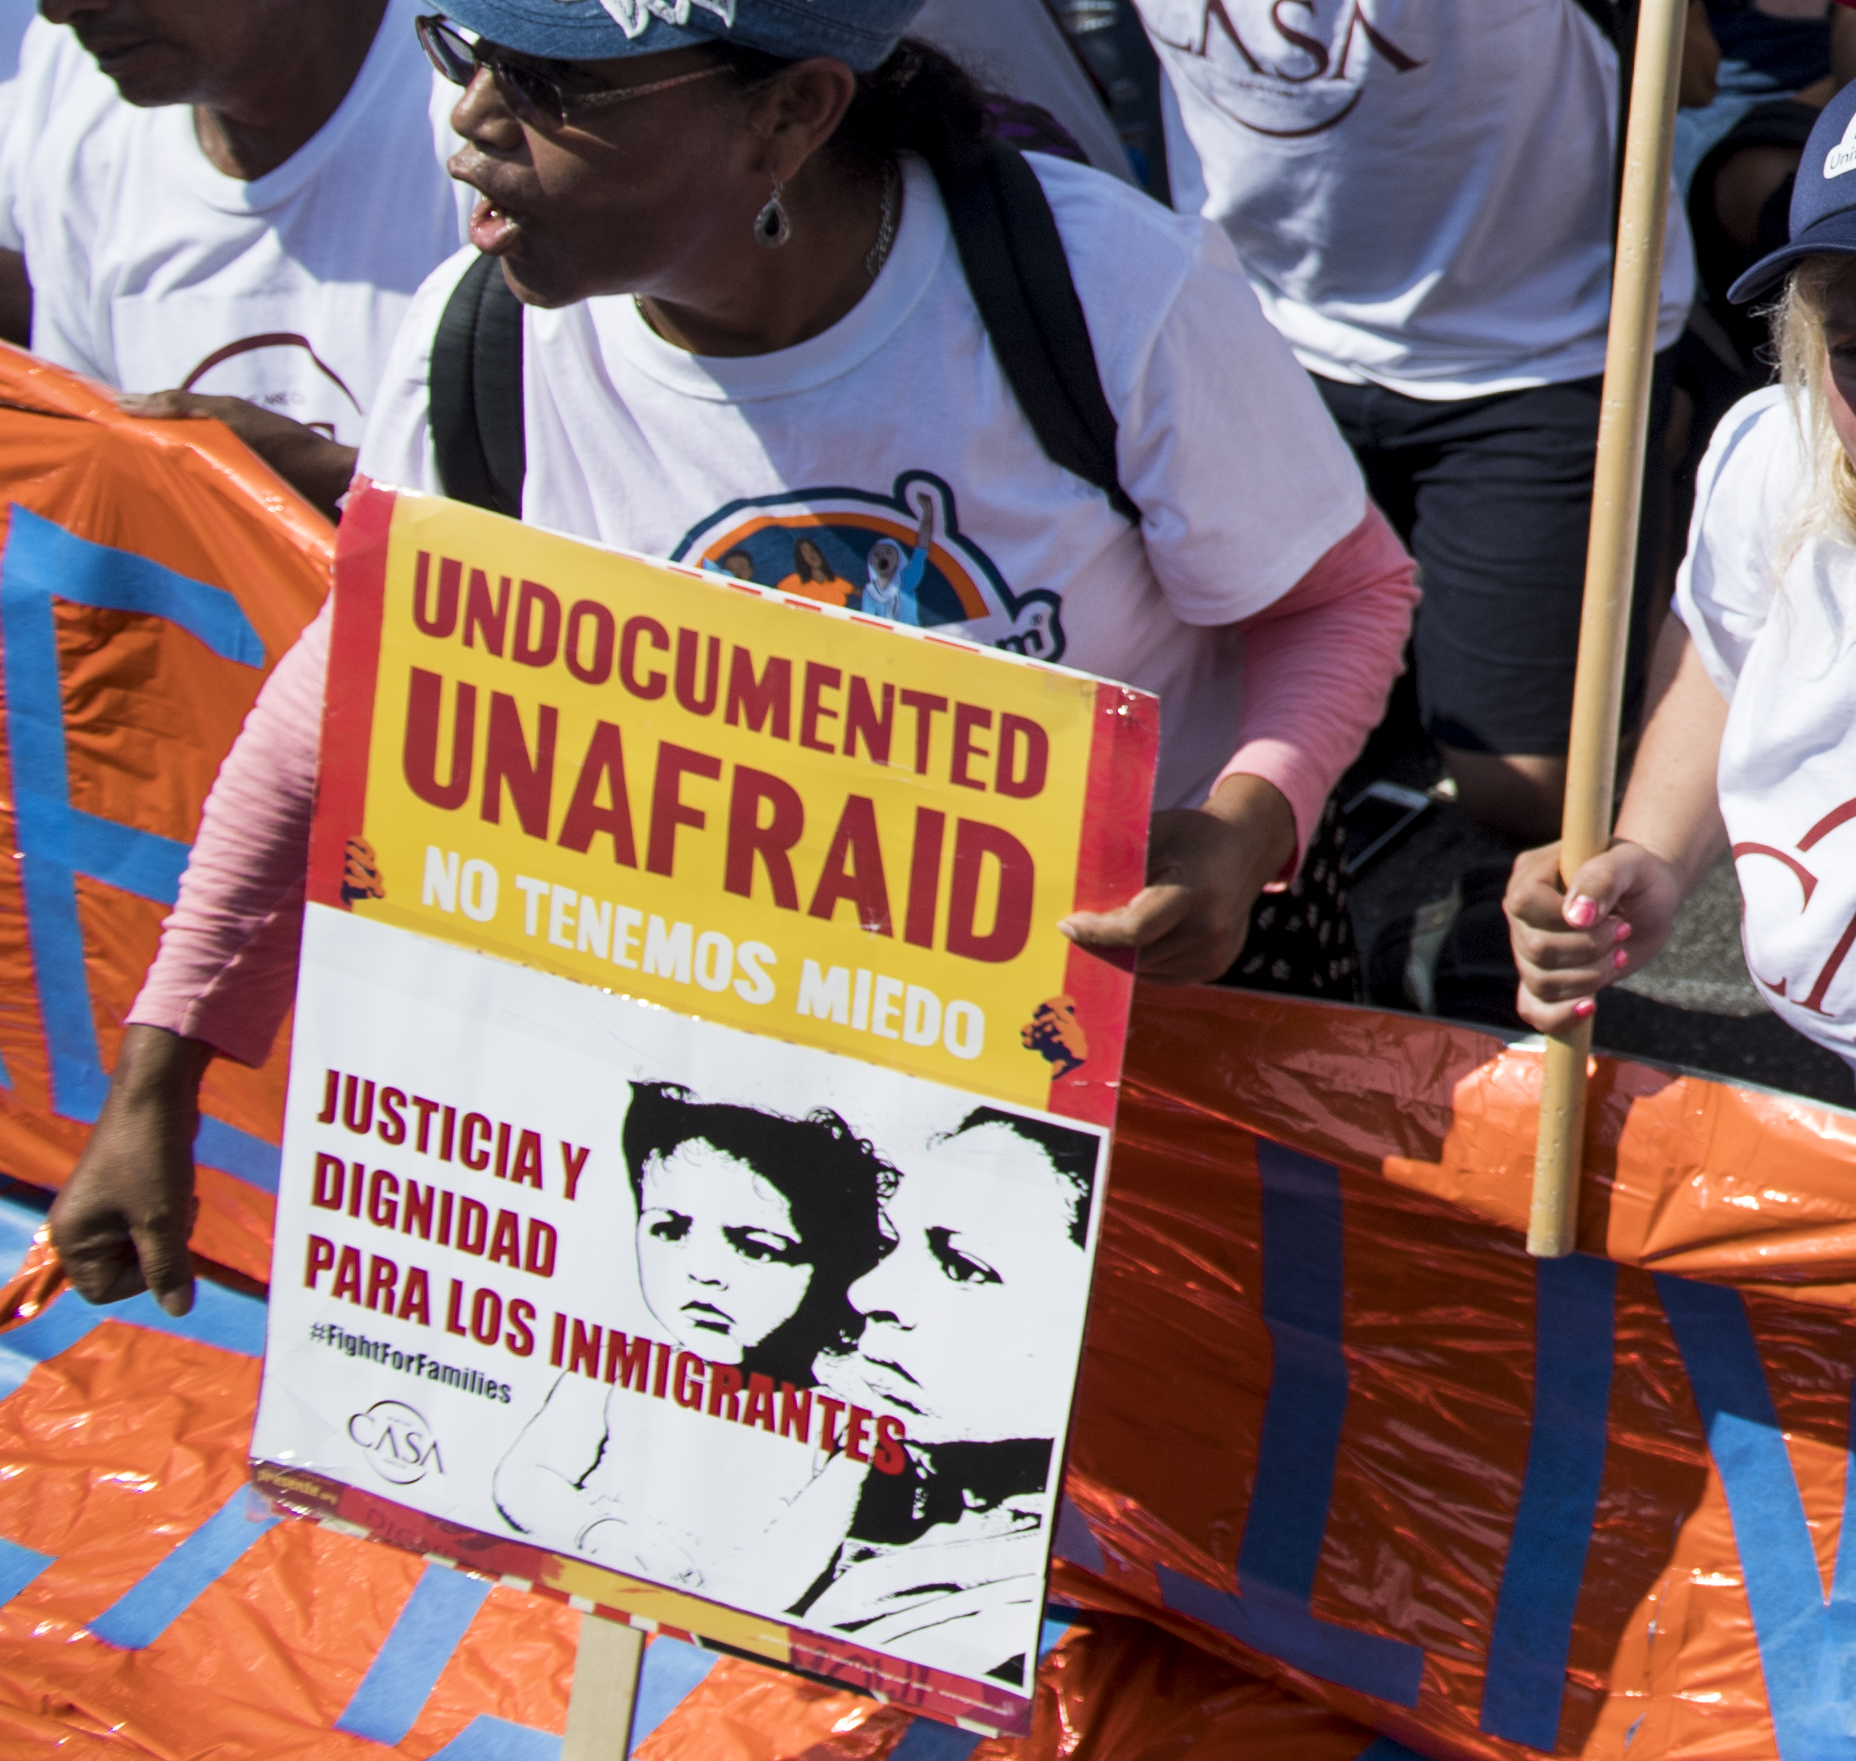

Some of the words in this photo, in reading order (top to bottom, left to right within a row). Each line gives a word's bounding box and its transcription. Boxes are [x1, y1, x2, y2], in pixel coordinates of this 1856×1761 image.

[413, 550, 1049, 799] UNDOCUMENTED
[402, 666, 1034, 964] UNAFRAID
[421, 845, 499, 922] NO
[515, 875, 778, 1006] TENEMOS
[796, 958, 986, 1060] MIEDO
[311, 1152, 557, 1279] DIGNIDAD
[316, 1069, 544, 1191] JUSTICIA
[559, 1141, 590, 1201] Y
[303, 1234, 431, 1327] PARA
[445, 1277, 536, 1358] LOS
[549, 1311, 907, 1476] INMIGRANTES
[310, 1322, 512, 1404] #FightForFamilies
[348, 1413, 445, 1475] CASA
